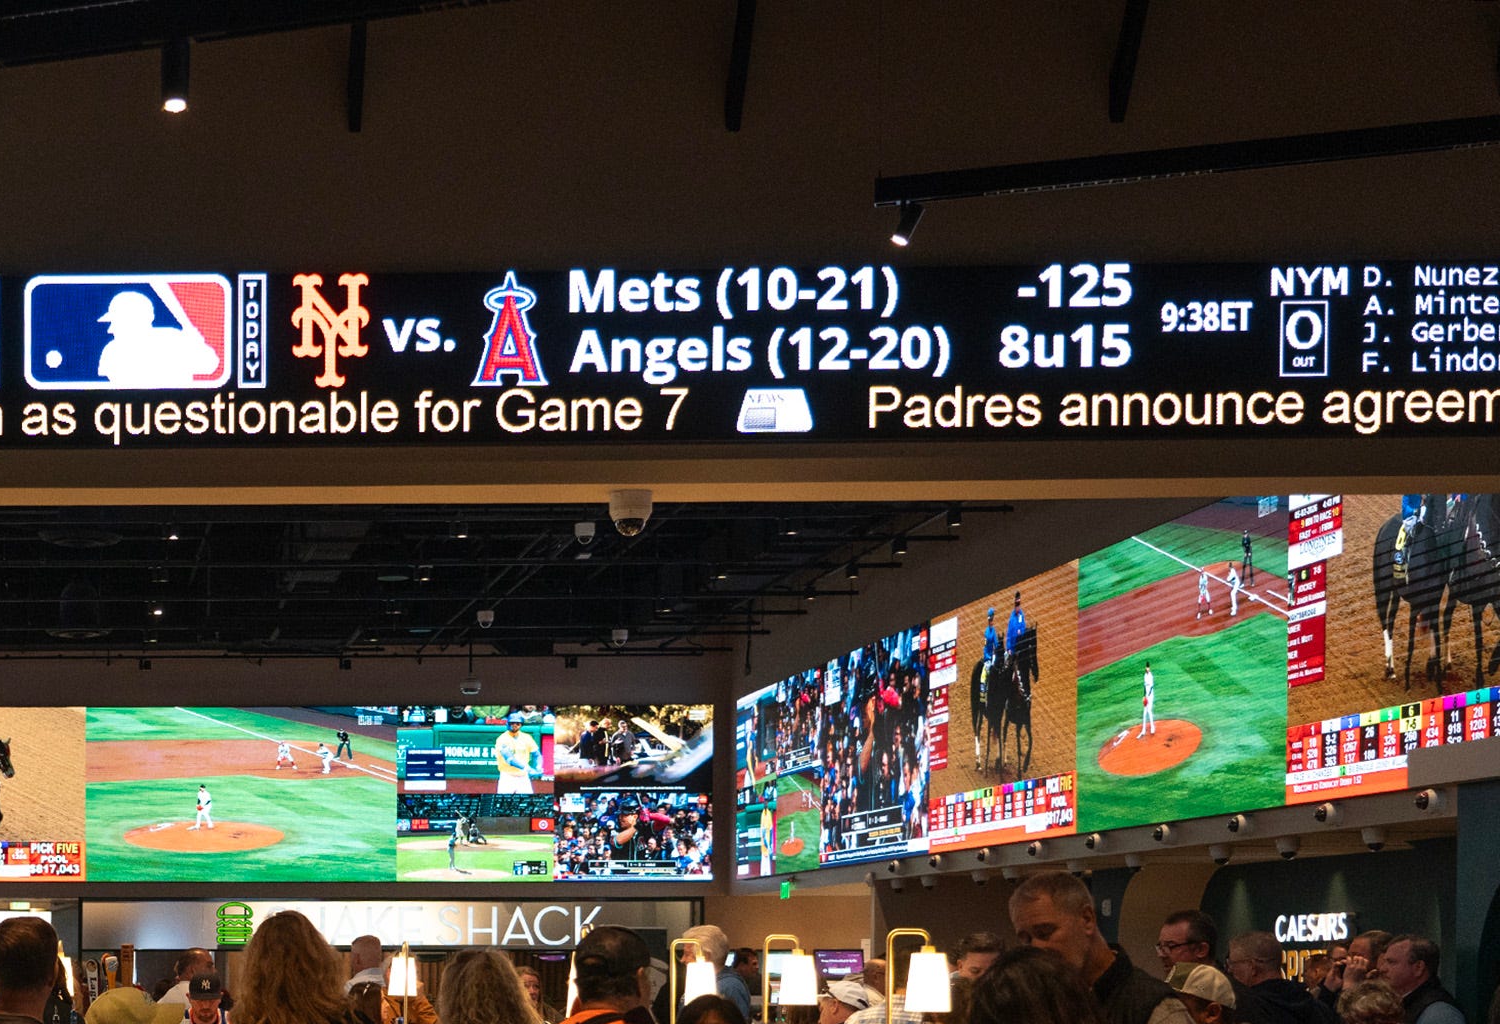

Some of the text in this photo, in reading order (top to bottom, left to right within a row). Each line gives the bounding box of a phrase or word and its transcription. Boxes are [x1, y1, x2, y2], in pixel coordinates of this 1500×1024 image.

[569, 264, 1132, 313] Mets (10-21) -125
[1270, 266, 1350, 296] NYM
[1364, 265, 1499, 287] D. Nunez
[1161, 300, 1253, 332] 9:38ET
[1363, 294, 1394, 315] A.
[246, 282, 259, 378] TODAY
[382, 317, 456, 352] vs.
[1363, 317, 1500, 343] J. Gerbe
[571, 325, 1132, 385] Angels (12-20) 8u15
[1292, 356, 1316, 367] OUT
[1362, 347, 1500, 372] F. Lindo
[22, 402, 76, 435] as
[93, 390, 399, 444] questionable
[414, 390, 480, 432] for
[496, 390, 643, 433] Game
[660, 388, 689, 430] 7
[869, 385, 1042, 428] Padres
[1059, 391, 1304, 426] announce
[1301, 569, 1307, 580] 6
[1451, 711, 1459, 722] 11
[445, 747, 480, 758] MORGAN
[482, 747, 489, 758] &
[1046, 775, 1073, 794] PICK FIVE
[1050, 795, 1067, 808] POOL
[31, 843, 78, 854] PICK FIVE
[41, 855, 68, 864] POOL
[436, 906, 602, 945] SHACK
[1275, 912, 1348, 942] CAESARS
